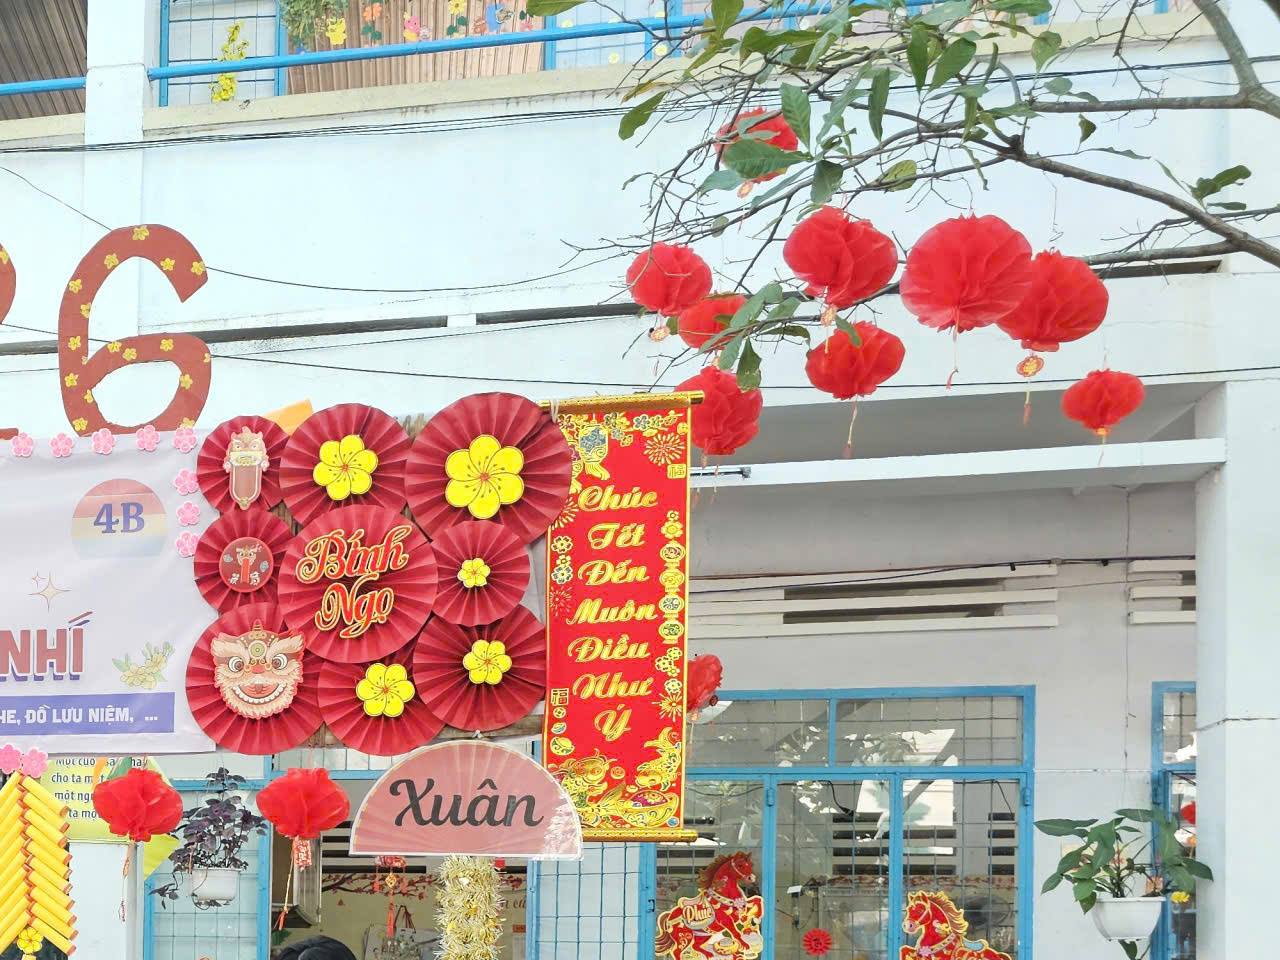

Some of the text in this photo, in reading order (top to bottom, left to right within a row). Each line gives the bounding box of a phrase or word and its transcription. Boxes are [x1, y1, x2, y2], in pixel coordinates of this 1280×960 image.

[577, 485, 659, 512] Chúc
[93, 501, 146, 534] 4B
[587, 522, 646, 550] Tết
[577, 559, 650, 586] Đến
[315, 573, 394, 639] Ngọ
[566, 598, 659, 625] Muôn
[567, 634, 651, 663] Điều
[572, 672, 654, 699] Như
[23, 703, 51, 725] ĐỒ
[52, 706, 83, 724] LƯU
[87, 704, 135, 726] NIỆM,
[594, 703, 633, 742] Ý
[51, 772, 105, 784] cho ta mt
[68, 809, 79, 819] ta
[388, 777, 545, 827] Xuân
